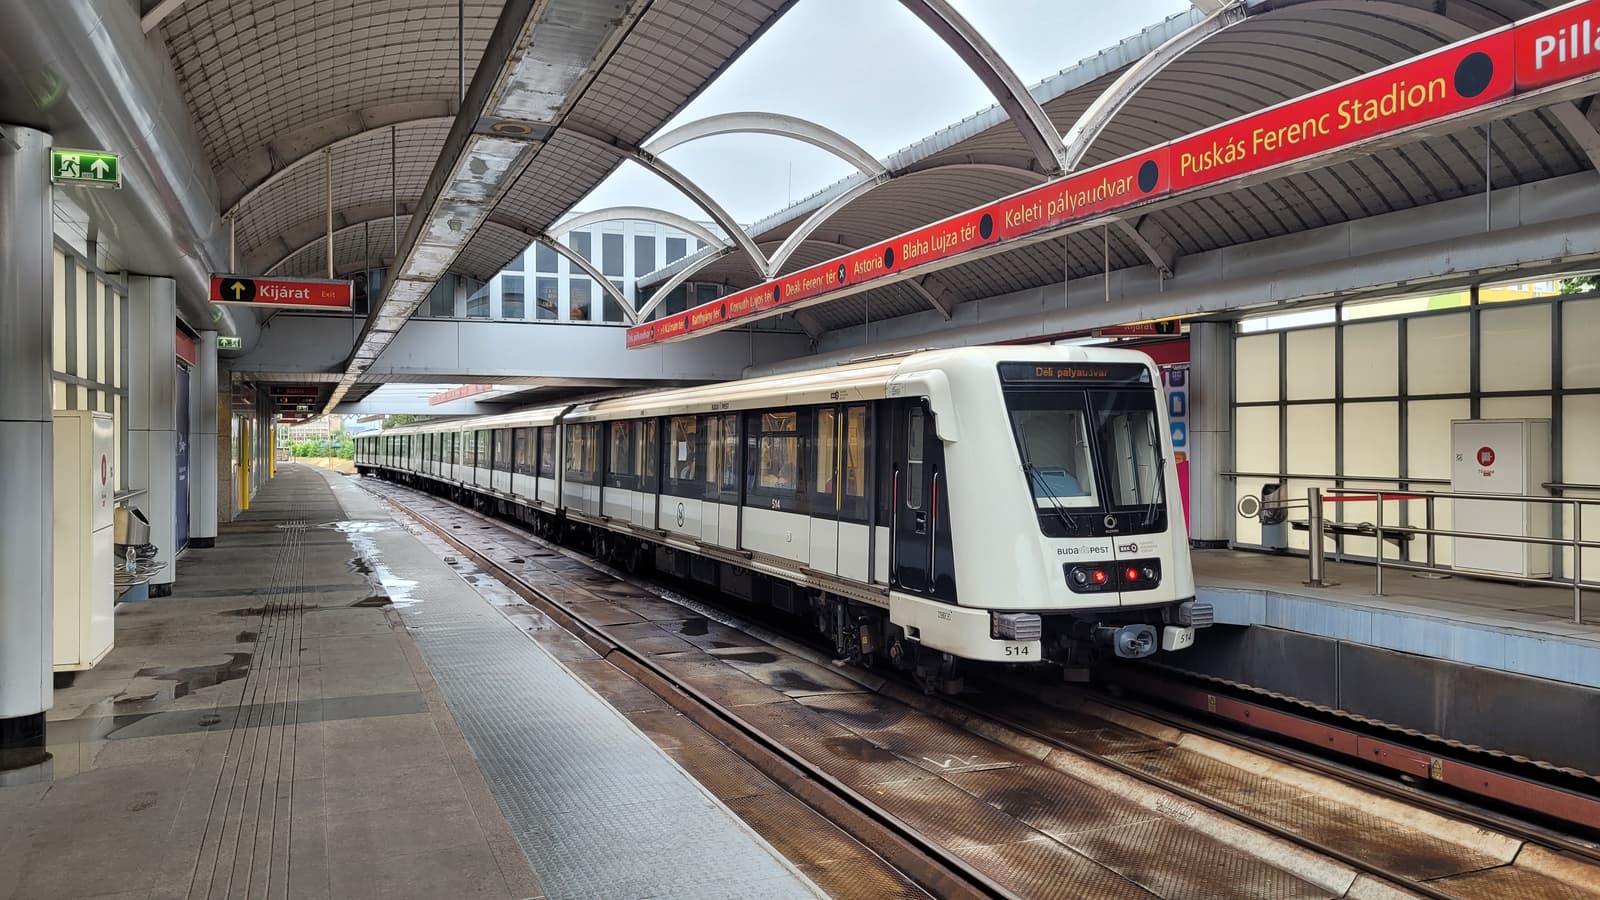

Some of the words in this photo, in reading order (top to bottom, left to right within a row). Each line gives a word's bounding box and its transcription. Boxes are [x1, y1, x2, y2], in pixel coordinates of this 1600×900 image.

[1181, 137, 1246, 176] Puskás
[1253, 113, 1330, 155] Ferenc
[1338, 78, 1446, 130] Stadion
[1005, 200, 1042, 229] Keleti
[1047, 175, 1133, 222] pályaudvar
[903, 240, 928, 260] Blaha
[931, 230, 958, 253] Lujza
[960, 222, 977, 242] tér
[853, 253, 883, 276] Astoria
[260, 285, 310, 301] Kijárat
[321, 290, 336, 298] Exit
[785, 279, 801, 297] Deák
[826, 268, 837, 285] tér
[770, 498, 781, 510] 514
[1180, 632, 1193, 644] 514
[1004, 646, 1030, 657] 514
